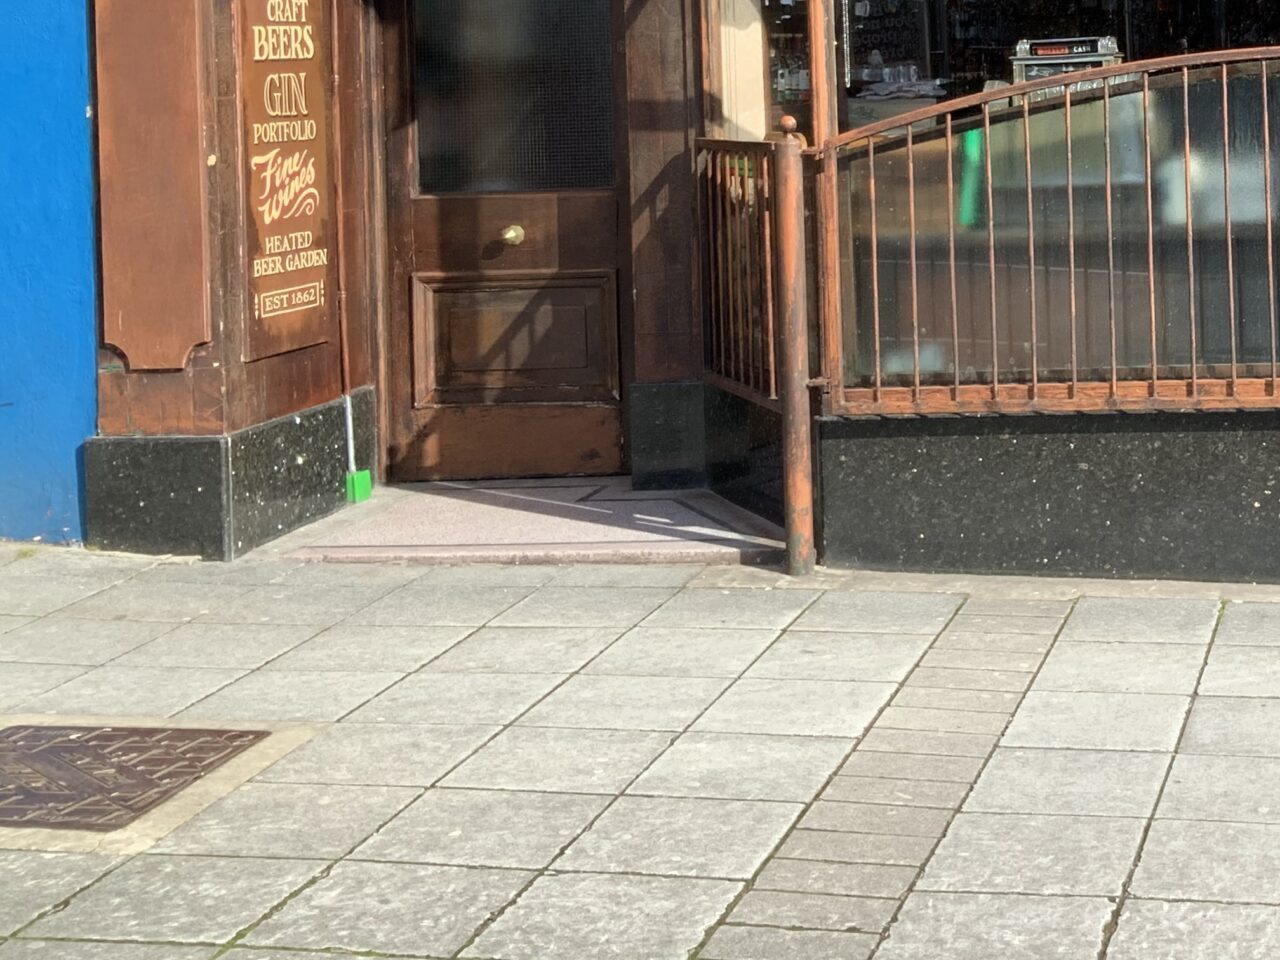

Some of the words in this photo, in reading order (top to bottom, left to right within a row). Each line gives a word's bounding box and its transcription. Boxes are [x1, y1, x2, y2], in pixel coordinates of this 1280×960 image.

[252, 24, 315, 61] BEERS
[263, 72, 308, 117] GIN
[253, 119, 317, 144] PORTFOLIO
[251, 148, 308, 199] Fine
[265, 231, 313, 255] HEATED
[253, 255, 285, 278] BEER
[285, 248, 328, 272] GARDEN
[264, 293, 289, 311] EST
[291, 288, 316, 305] 1862
